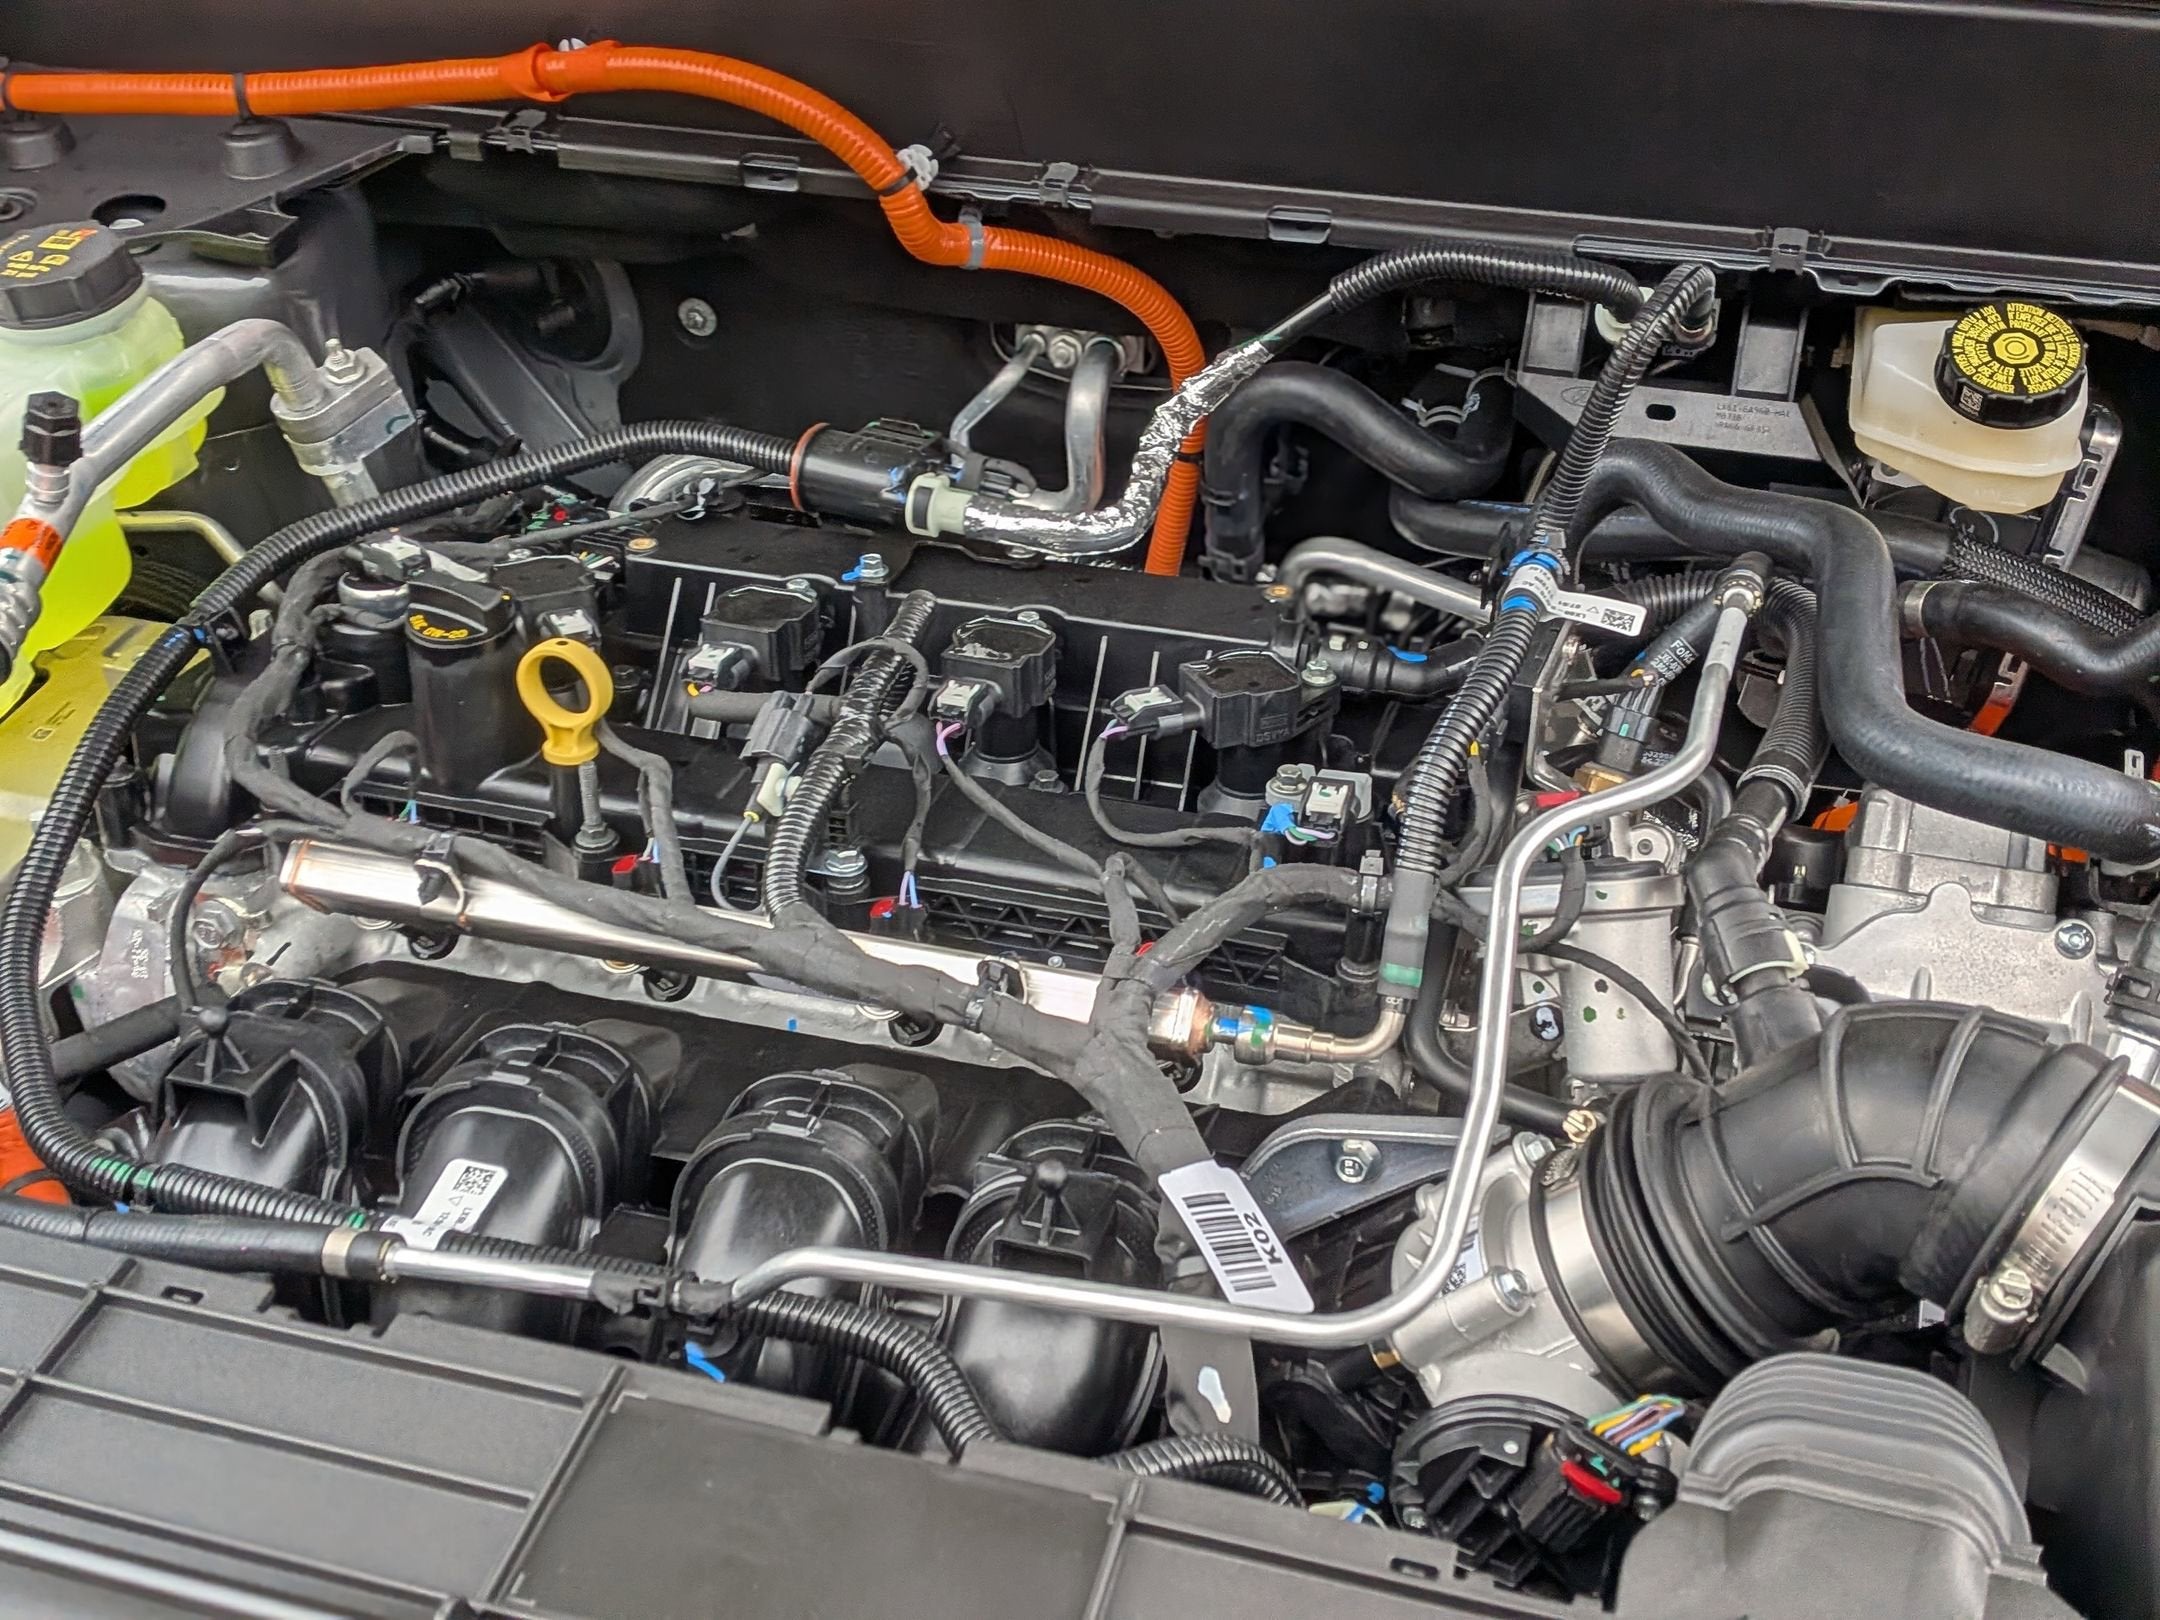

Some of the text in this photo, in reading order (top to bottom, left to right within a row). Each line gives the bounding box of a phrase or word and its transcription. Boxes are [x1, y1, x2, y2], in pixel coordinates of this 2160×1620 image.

[1979, 304, 1997, 317] DOT
[2006, 302, 2046, 317] ATTENTION
[1953, 353, 1977, 376] SEALED
[1977, 364, 1994, 378] USE
[1992, 372, 2014, 385] ONLY
[1987, 360, 2015, 377] FILLER
[1972, 373, 2015, 394] CONTAINER
[1243, 1211, 1284, 1265] K02
